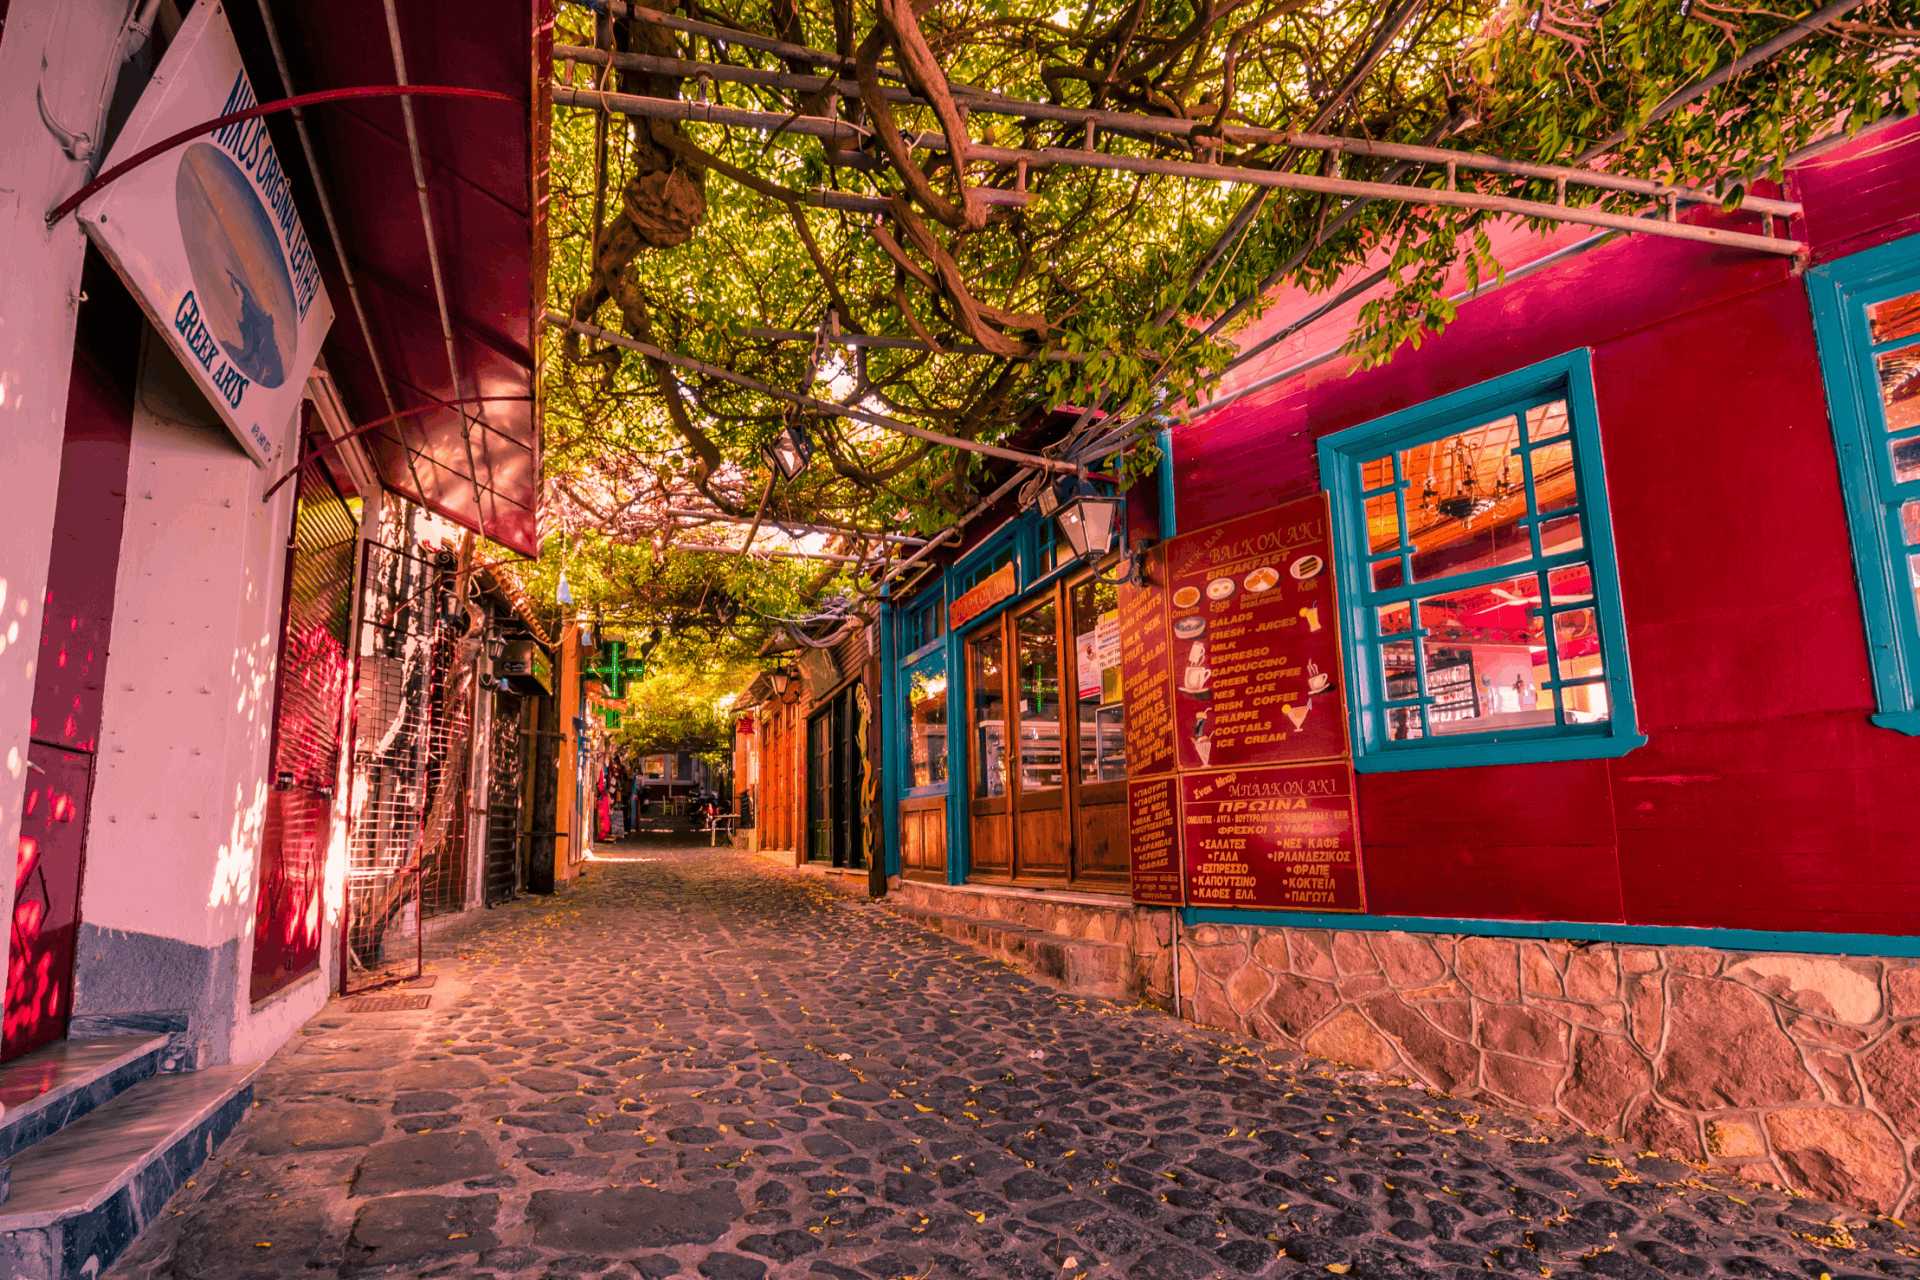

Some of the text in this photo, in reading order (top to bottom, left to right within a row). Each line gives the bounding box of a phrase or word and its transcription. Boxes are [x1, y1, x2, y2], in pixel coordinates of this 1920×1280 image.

[210, 68, 321, 324] NIKOS ORIGINAL LEATHER
[175, 290, 250, 409] GREEK ARTS
[1206, 551, 1290, 580] BREAKFAST
[1209, 611, 1254, 628] SALADS
[1210, 627, 1245, 641] FRESH
[1255, 617, 1297, 632] JUICES
[1211, 641, 1236, 652] MILK
[1211, 647, 1270, 665] ESPRESSO
[1256, 667, 1302, 682] COFFEE
[1214, 683, 1277, 700] NES CAFE
[1214, 692, 1299, 712] IRISH COFFEE
[1215, 710, 1259, 725] FRAPPE
[1215, 721, 1272, 737] COCTAILS
[1216, 732, 1287, 748] ICE CREAM
[1218, 799, 1308, 812] ΠΡΩΙΝΑ
[1205, 838, 1246, 850] ΣΑΛΑΤΕΣ
[1308, 837, 1340, 848] ΚΑΦΕ
[1214, 850, 1239, 861] ΓΑΛΑ
[1203, 863, 1248, 874] ΕΣΠΡΕΣΣΟ
[1198, 887, 1231, 899] ΚΑΦΕΣ
[1291, 892, 1335, 903] ΠΑΓΩΤΑ
